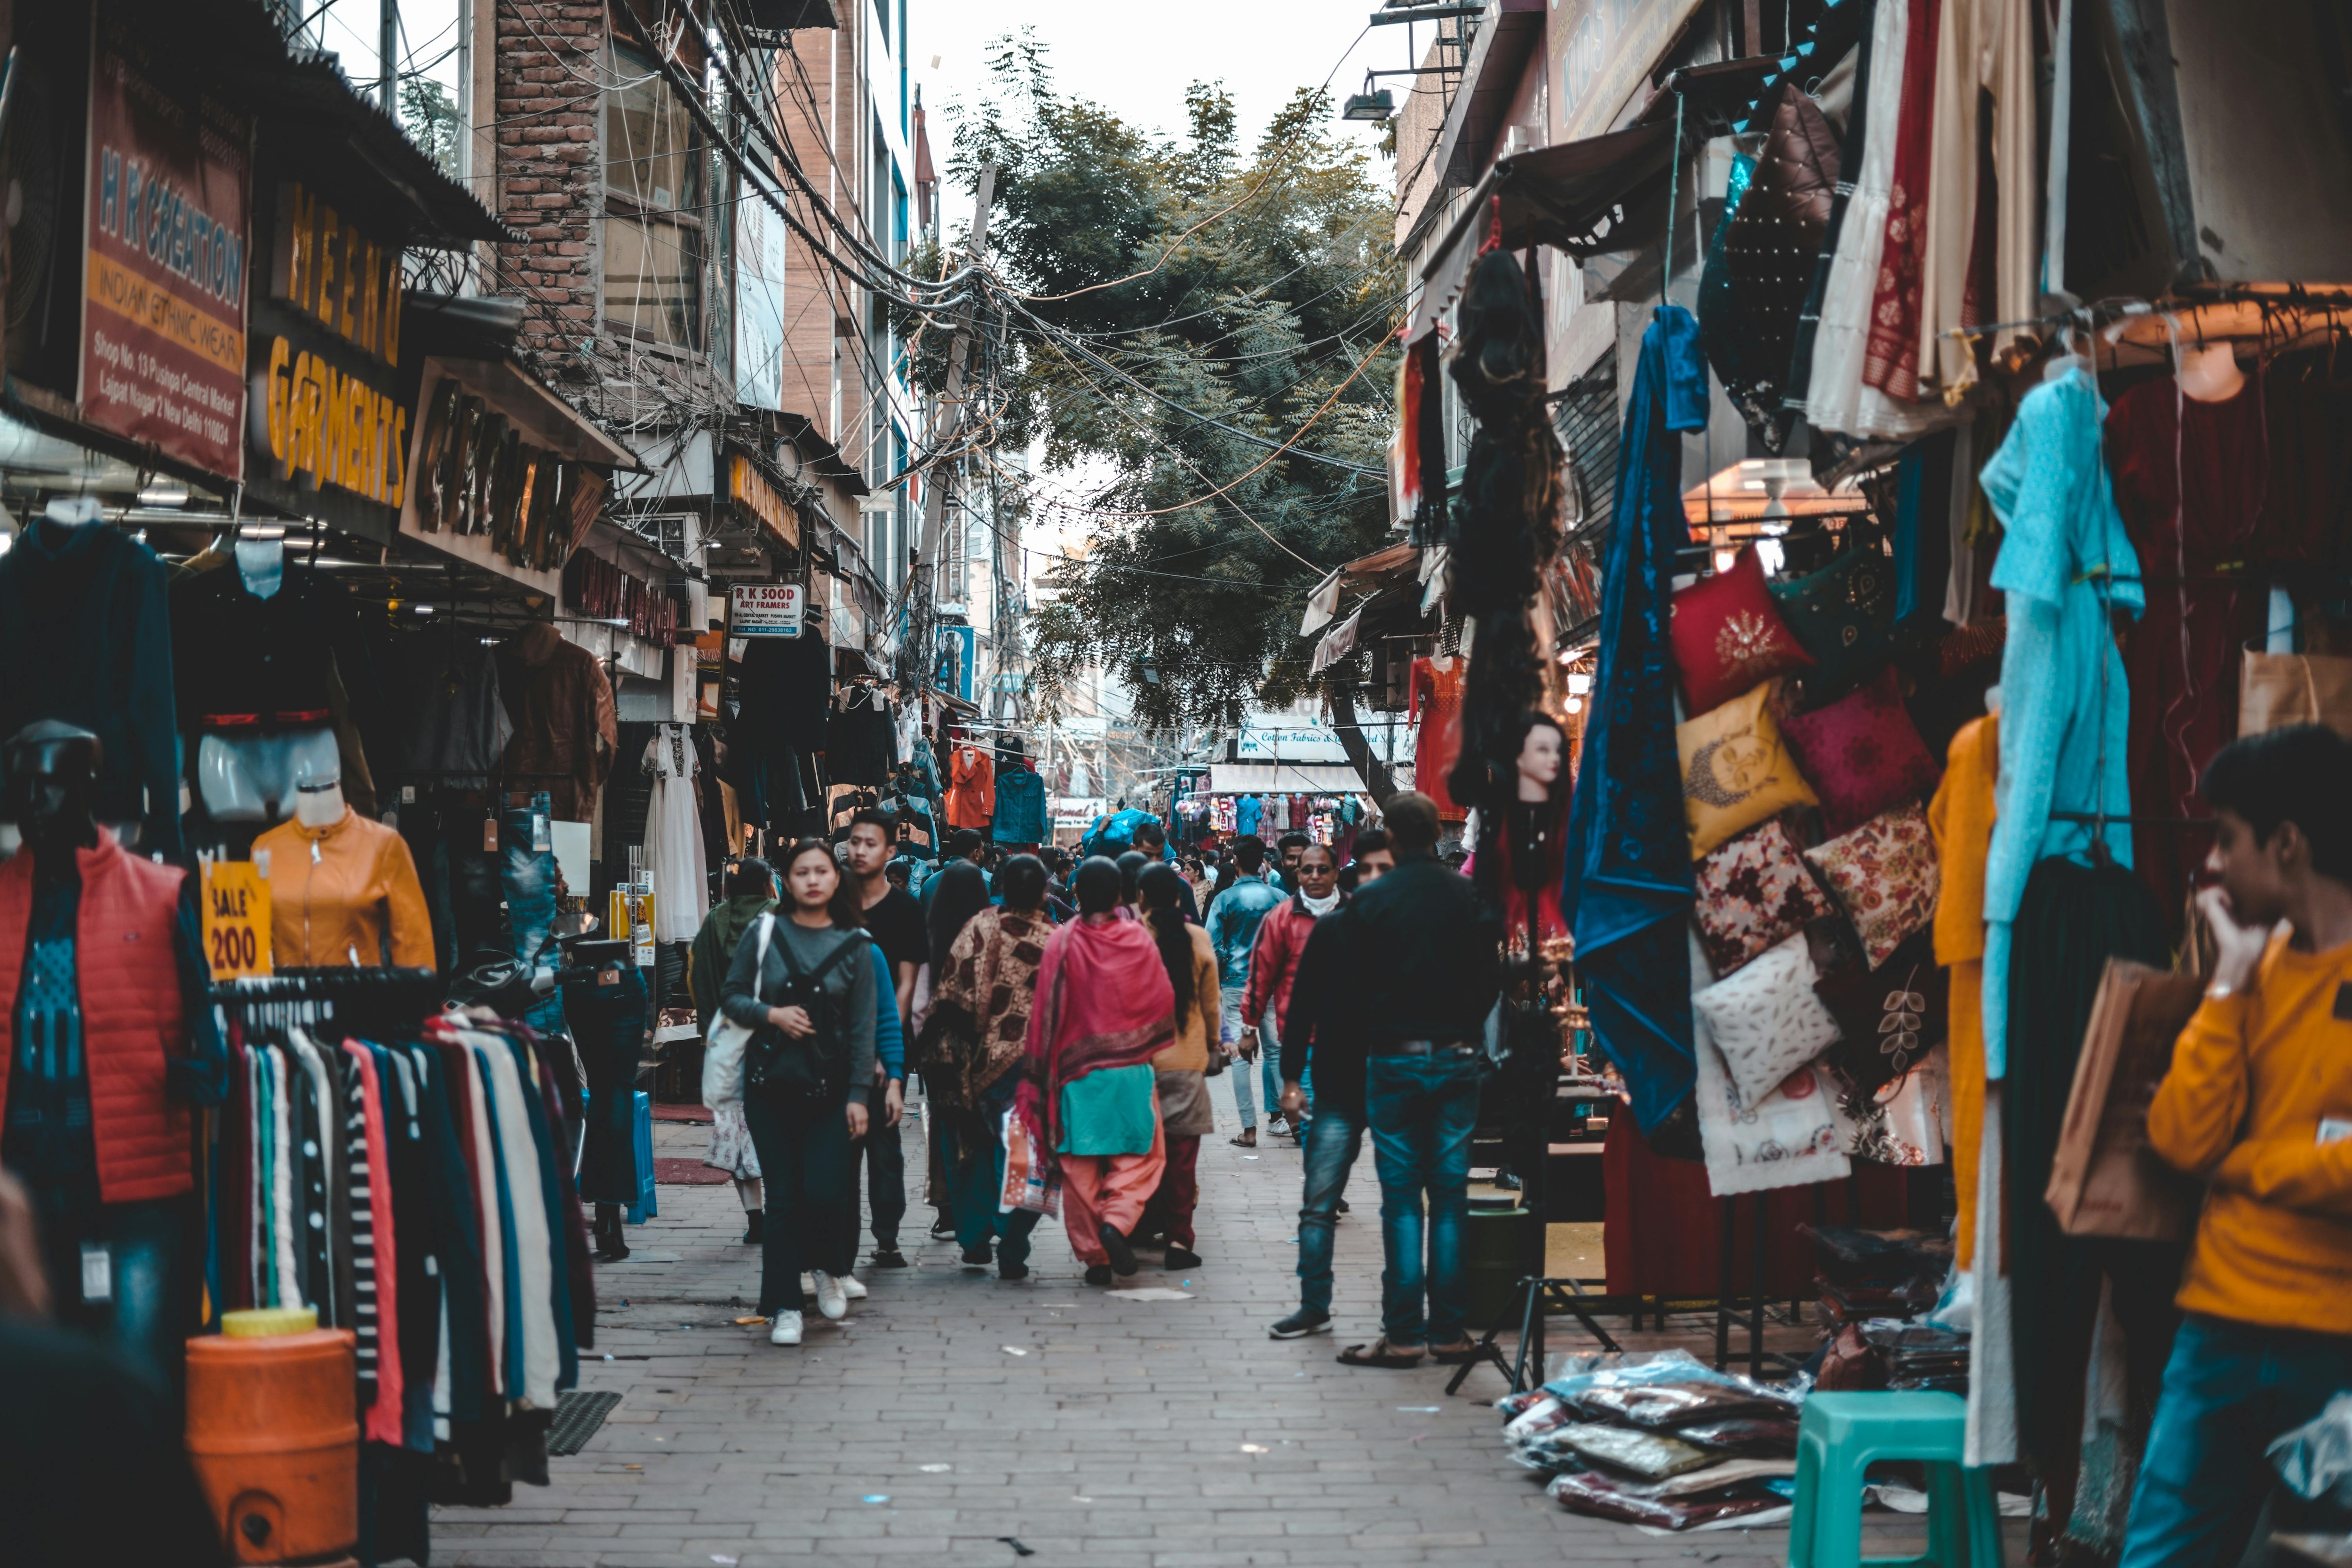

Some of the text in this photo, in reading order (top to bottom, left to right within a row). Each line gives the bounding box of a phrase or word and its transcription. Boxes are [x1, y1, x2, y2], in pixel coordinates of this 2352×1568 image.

[1563, 0, 1605, 129] KIDS
[99, 145, 121, 237] H
[145, 175, 242, 310] CREATION
[99, 264, 148, 315] INDIAN
[151, 293, 196, 344] ETHNIC
[289, 181, 403, 368] MEENU
[94, 330, 119, 369] Shop
[138, 352, 148, 378] 13
[149, 357, 180, 394] Pushpa
[182, 373, 208, 406] Central
[210, 387, 235, 418] Market
[99, 369, 229, 446] Lajpat Nagar 2 New Delhi 110024
[268, 335, 406, 509] GARMENTS
[736, 588, 795, 600] R K SOOD
[1261, 732, 1287, 741] Coton
[1290, 732, 1321, 742] Fabrics
[212, 888, 247, 918] SALE
[211, 925, 256, 970] 200
